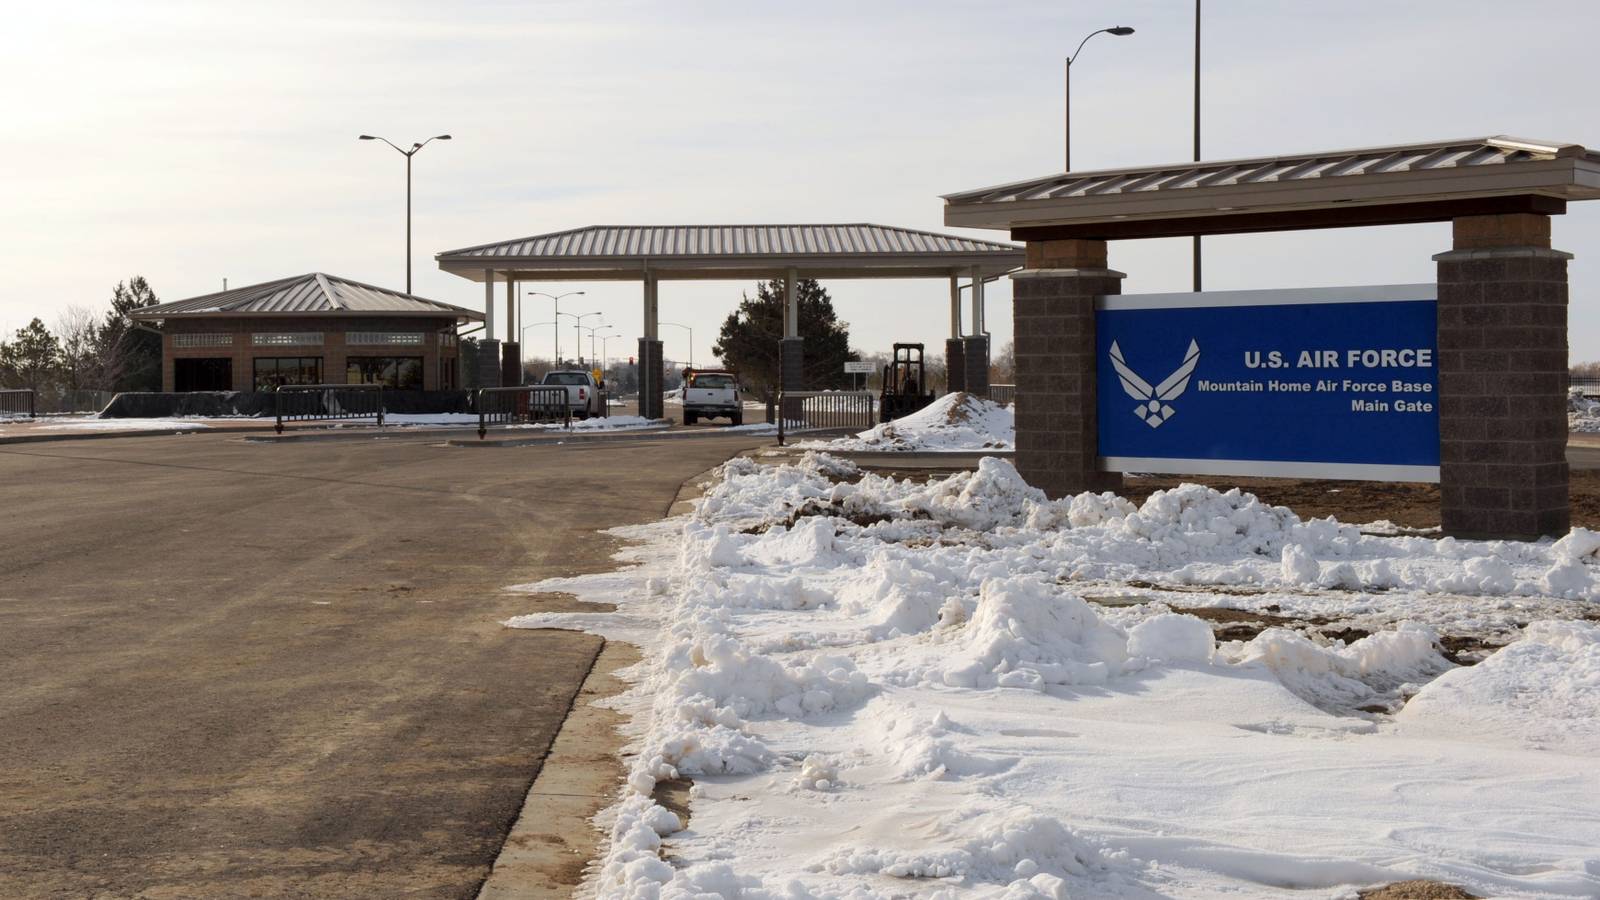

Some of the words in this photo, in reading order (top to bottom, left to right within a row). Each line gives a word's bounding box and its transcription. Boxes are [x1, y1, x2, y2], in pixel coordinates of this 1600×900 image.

[1245, 351, 1289, 369] U.S.
[1297, 350, 1339, 368] AIR
[1348, 349, 1432, 368] FORCE
[1198, 380, 1263, 392] Mountain
[1268, 380, 1312, 392] Home
[1316, 380, 1338, 392] Air
[1343, 380, 1387, 392] Force
[1392, 380, 1433, 393] Base
[1352, 400, 1389, 412] Main
[1394, 400, 1433, 412] Gate
